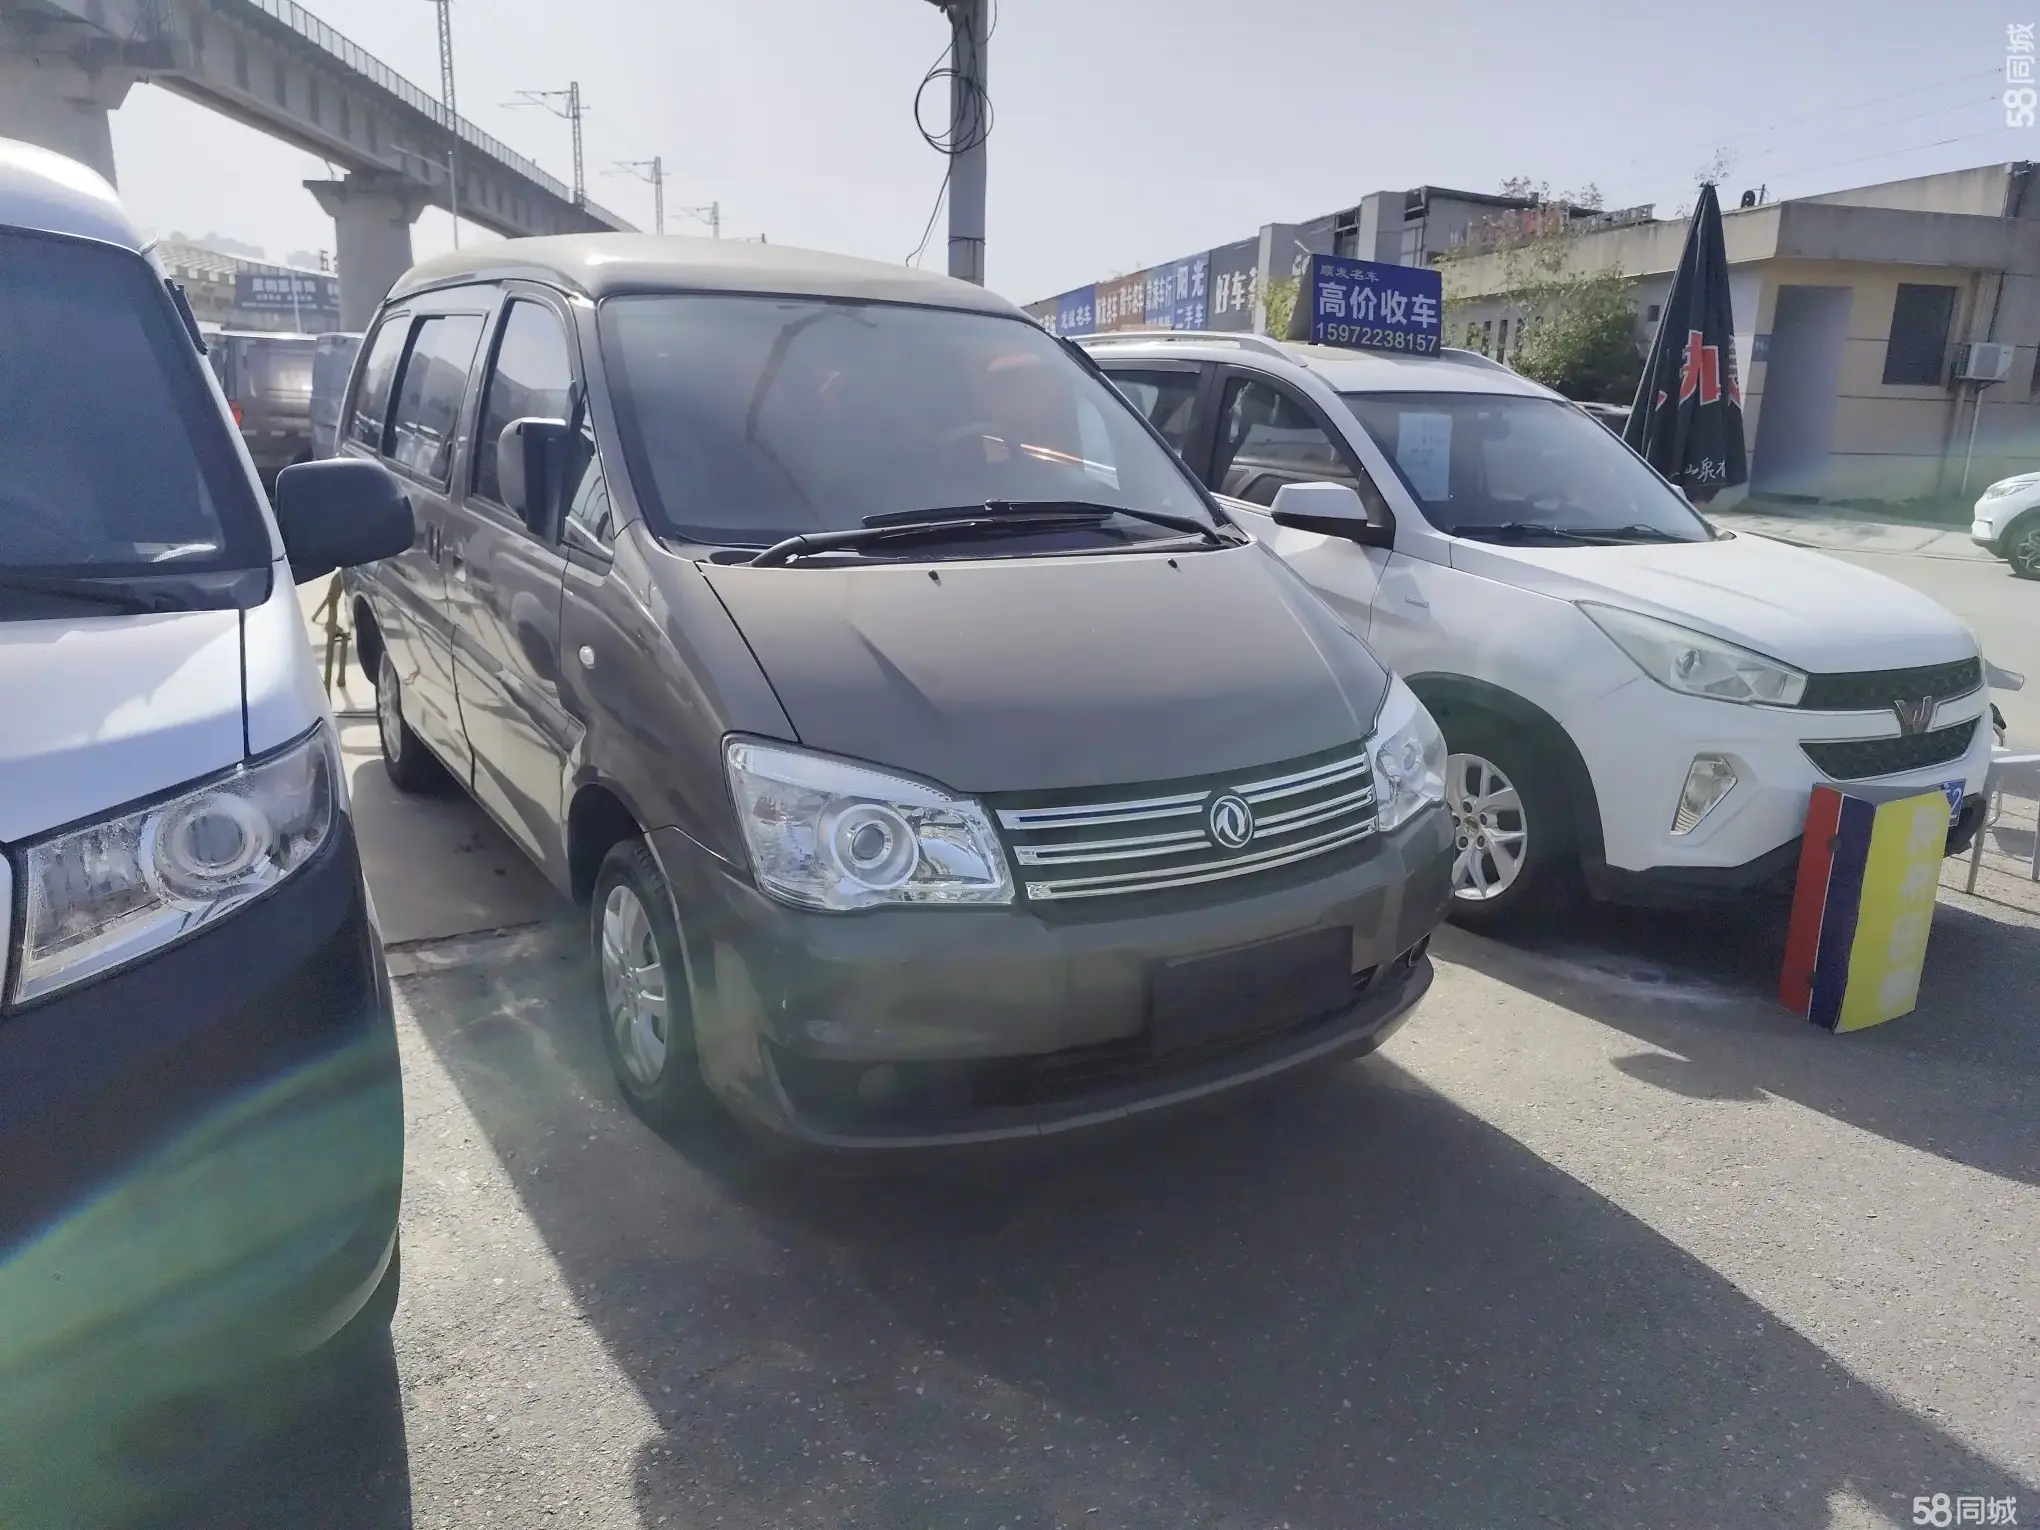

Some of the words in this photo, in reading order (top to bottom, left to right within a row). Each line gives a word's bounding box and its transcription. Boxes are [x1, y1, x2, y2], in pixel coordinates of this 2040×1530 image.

[1176, 260, 1205, 300] 阳光
[1319, 264, 1380, 283] 顺发名车
[1175, 302, 1204, 331] 二手车
[1318, 282, 1438, 329] 高价收车
[1316, 321, 1438, 352] 15972238157
